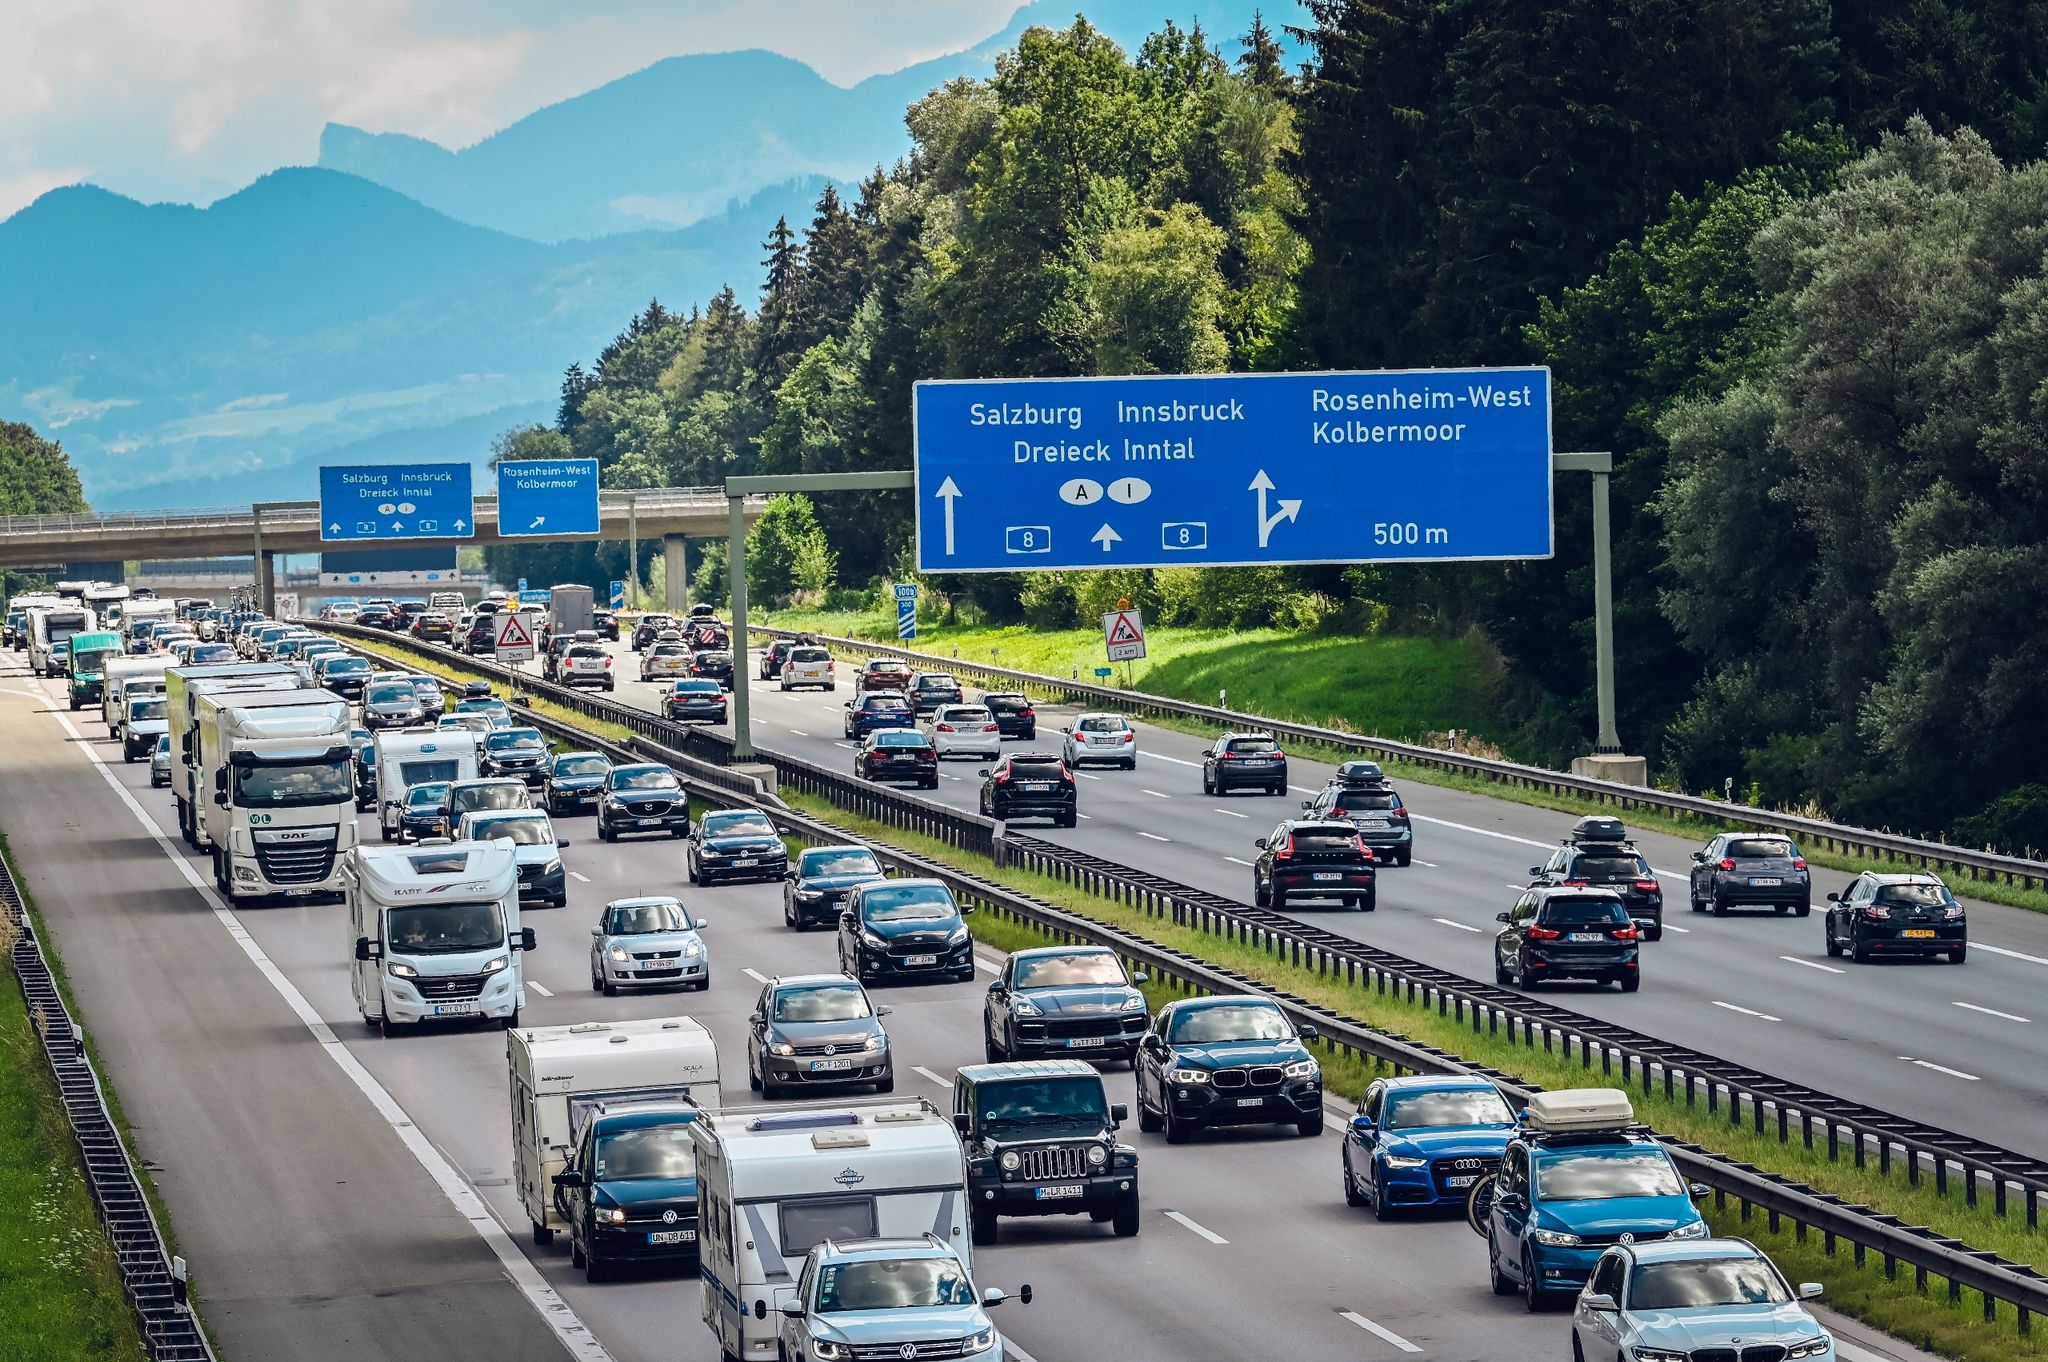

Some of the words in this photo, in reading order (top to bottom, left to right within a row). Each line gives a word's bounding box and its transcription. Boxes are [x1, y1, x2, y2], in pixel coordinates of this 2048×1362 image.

[1313, 385, 1531, 412] Rosenheim-West
[970, 402, 1082, 430] Salzburg
[1118, 398, 1245, 423] Innsbruck
[1313, 420, 1466, 444] Kolbermoor
[1014, 439, 1111, 463] Dreieck
[1124, 437, 1195, 461] Inntal
[342, 473, 388, 486] Salzburg
[401, 471, 452, 482] Innsbruck
[504, 465, 591, 477] Rosenheim-West
[517, 479, 578, 489] Kolbermoor
[1127, 483, 1132, 499] I
[359, 488, 399, 498] Dreieck
[403, 487, 433, 497] Inntal
[1075, 484, 1089, 501] A
[1023, 531, 1034, 548] 8
[1179, 527, 1190, 544] 8
[1374, 522, 1419, 545] 500
[1425, 527, 1448, 544] m
[281, 832, 311, 840] DAF
[828, 1060, 833, 1068] F
[834, 1060, 850, 1068] 1201
[1040, 1187, 1047, 1196] M
[1050, 1186, 1061, 1196] LR
[1062, 1185, 1082, 1195] 1411
[652, 1232, 664, 1243] UN
[680, 1231, 695, 1240] 611
